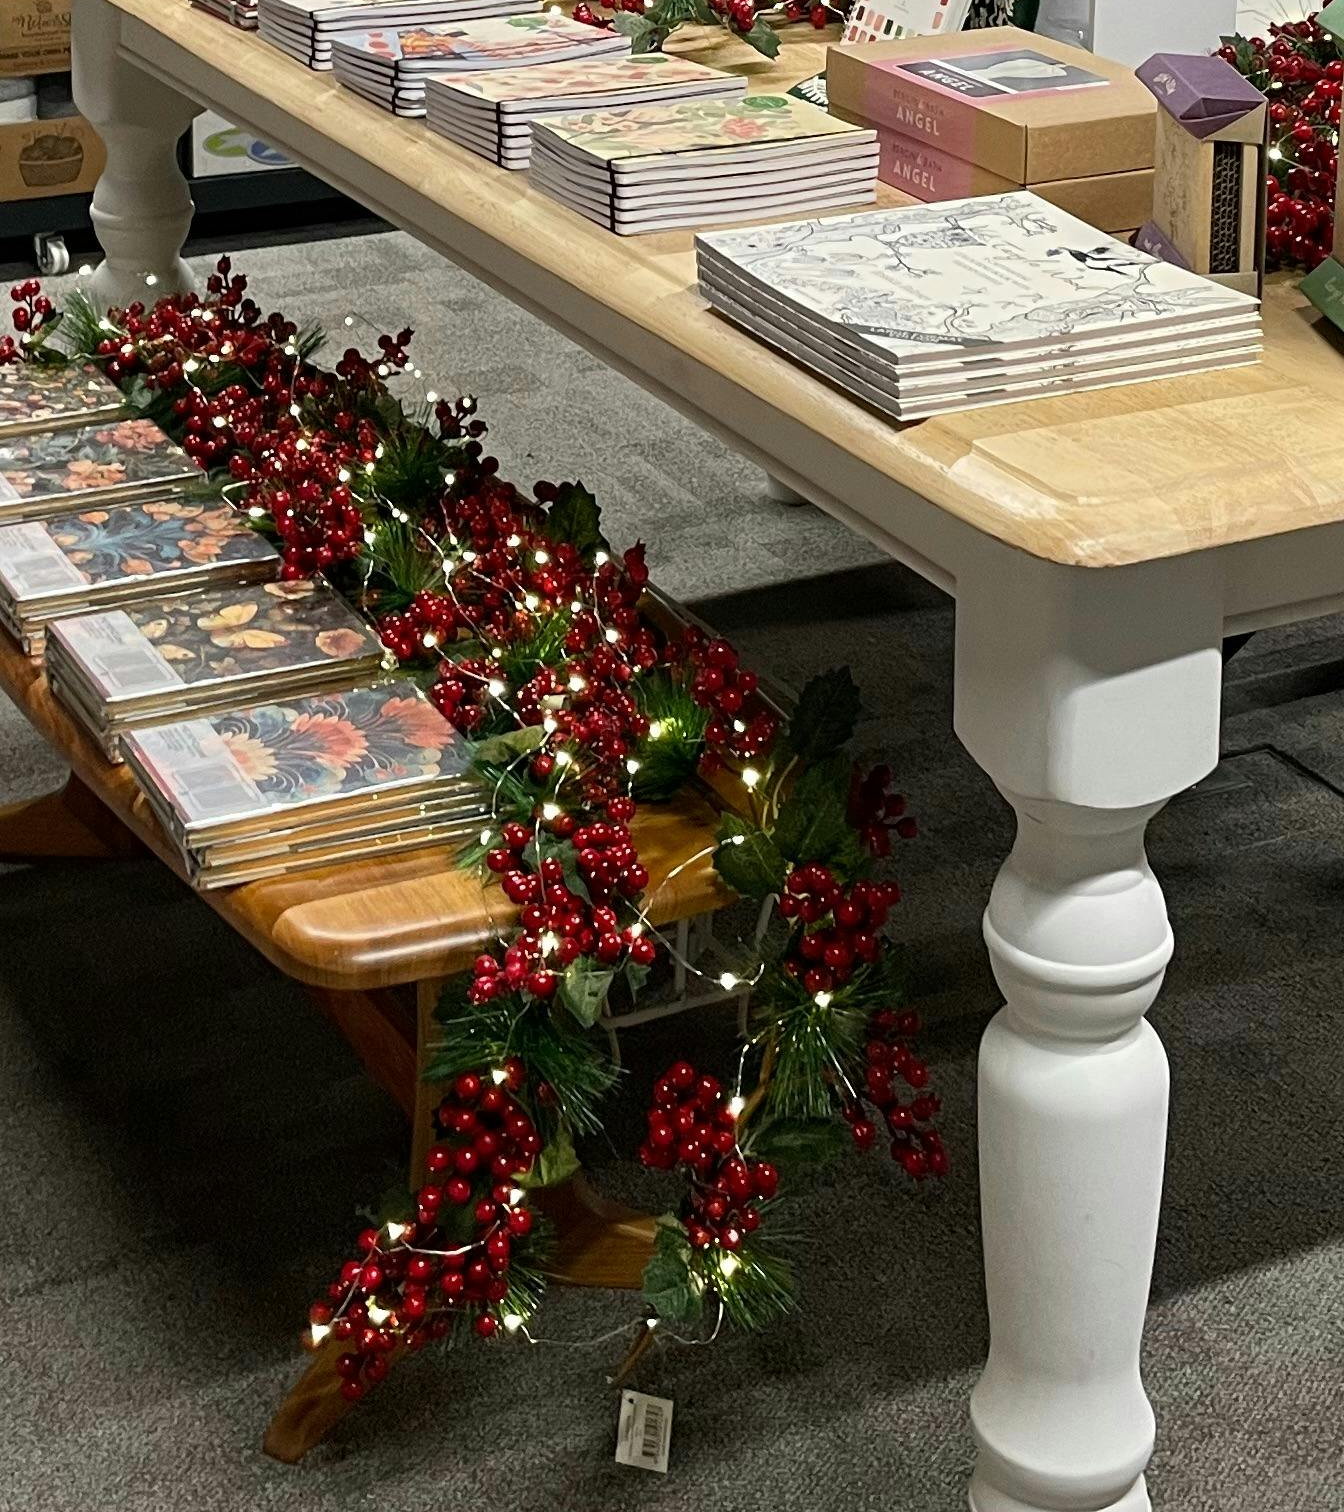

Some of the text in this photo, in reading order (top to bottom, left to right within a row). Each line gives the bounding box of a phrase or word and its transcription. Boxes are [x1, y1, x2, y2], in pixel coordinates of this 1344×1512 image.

[917, 70, 975, 91] ANGEL
[896, 105, 940, 136] ANGEL
[893, 159, 936, 192] ANGEL
